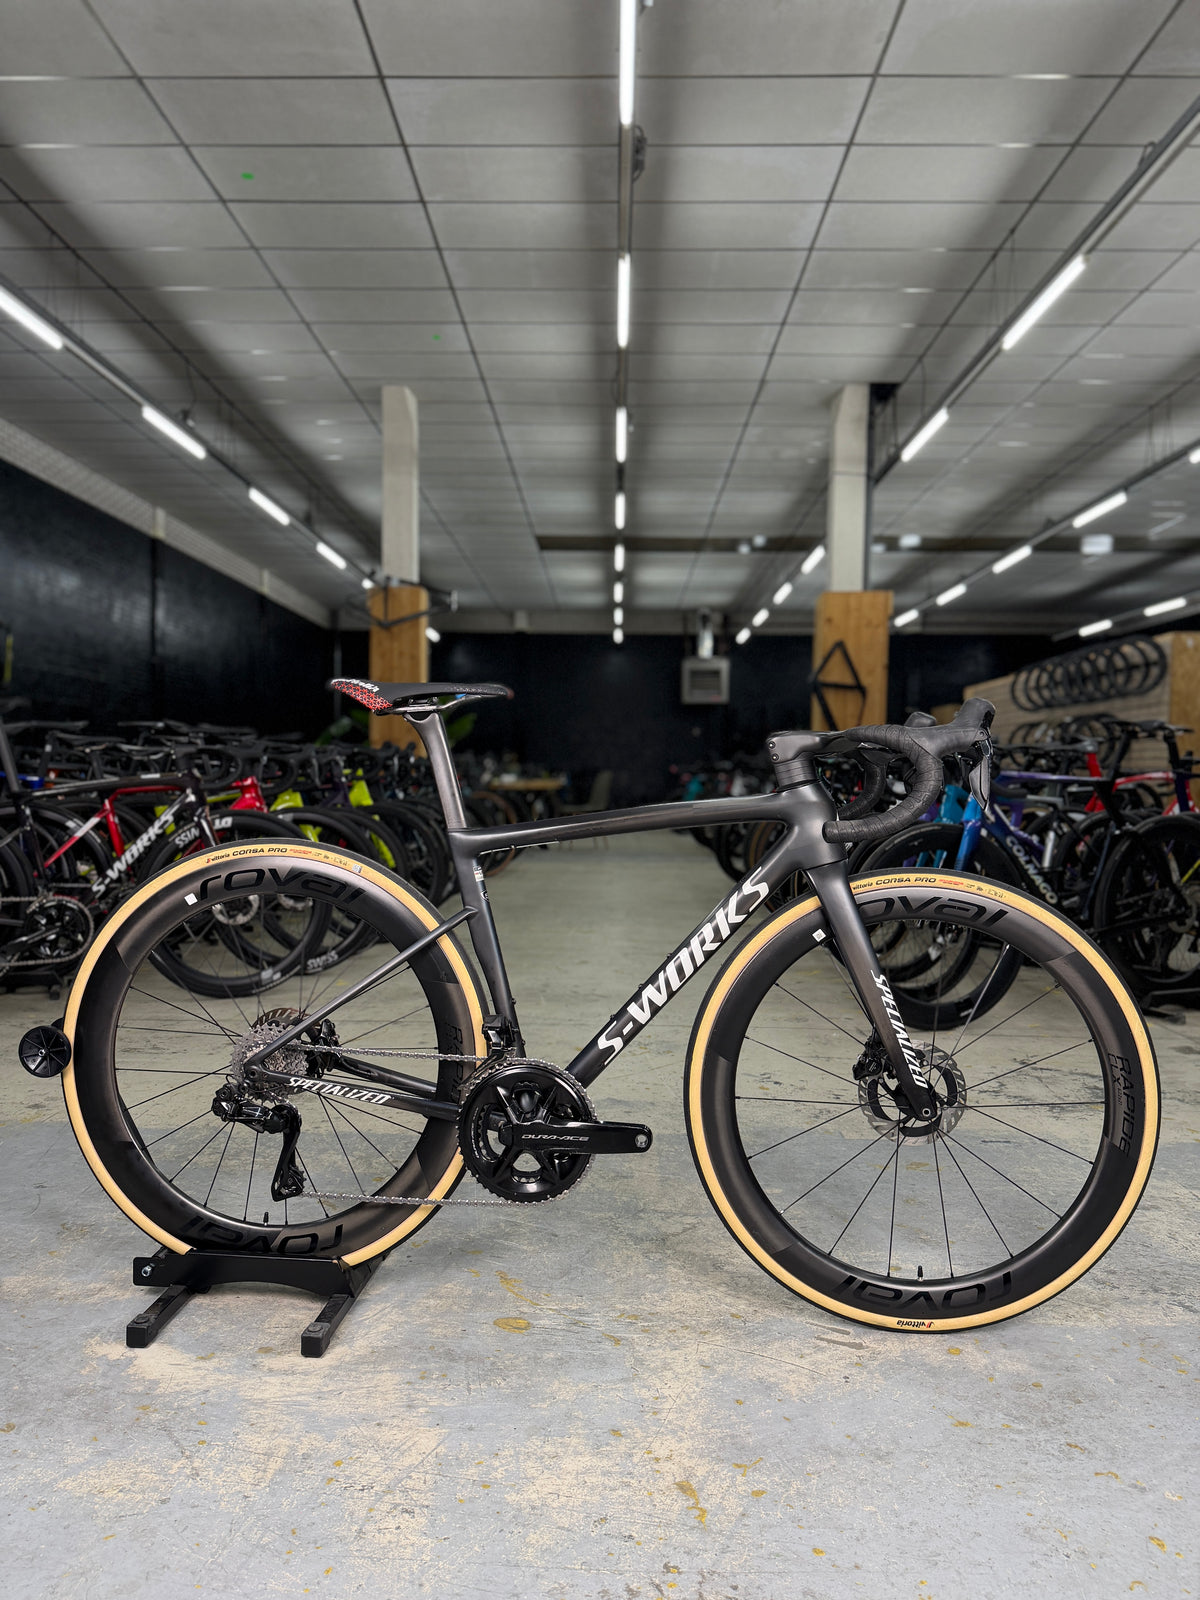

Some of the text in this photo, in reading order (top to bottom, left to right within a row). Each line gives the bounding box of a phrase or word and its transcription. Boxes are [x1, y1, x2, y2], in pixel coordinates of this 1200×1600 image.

[91, 803, 180, 899] S-WORKS
[211, 852, 231, 862] vittoria
[232, 847, 265, 857] CORSA
[200, 868, 367, 904] roval
[852, 882, 874, 891] vittoria
[875, 877, 911, 886] CORSA
[1006, 835, 1058, 905] COLNAGO
[857, 895, 1009, 928] oval
[597, 866, 770, 1066] S-WORKS
[870, 969, 928, 1089] SPECIALIZED
[1107, 1053, 1122, 1086] CLX
[288, 1077, 392, 1105] SPECIALIZED
[1115, 1055, 1136, 1158] RAPIDE
[521, 1133, 590, 1142] DURA-ACE
[832, 1270, 1012, 1312] roval
[896, 1319, 926, 1329] vittoria
